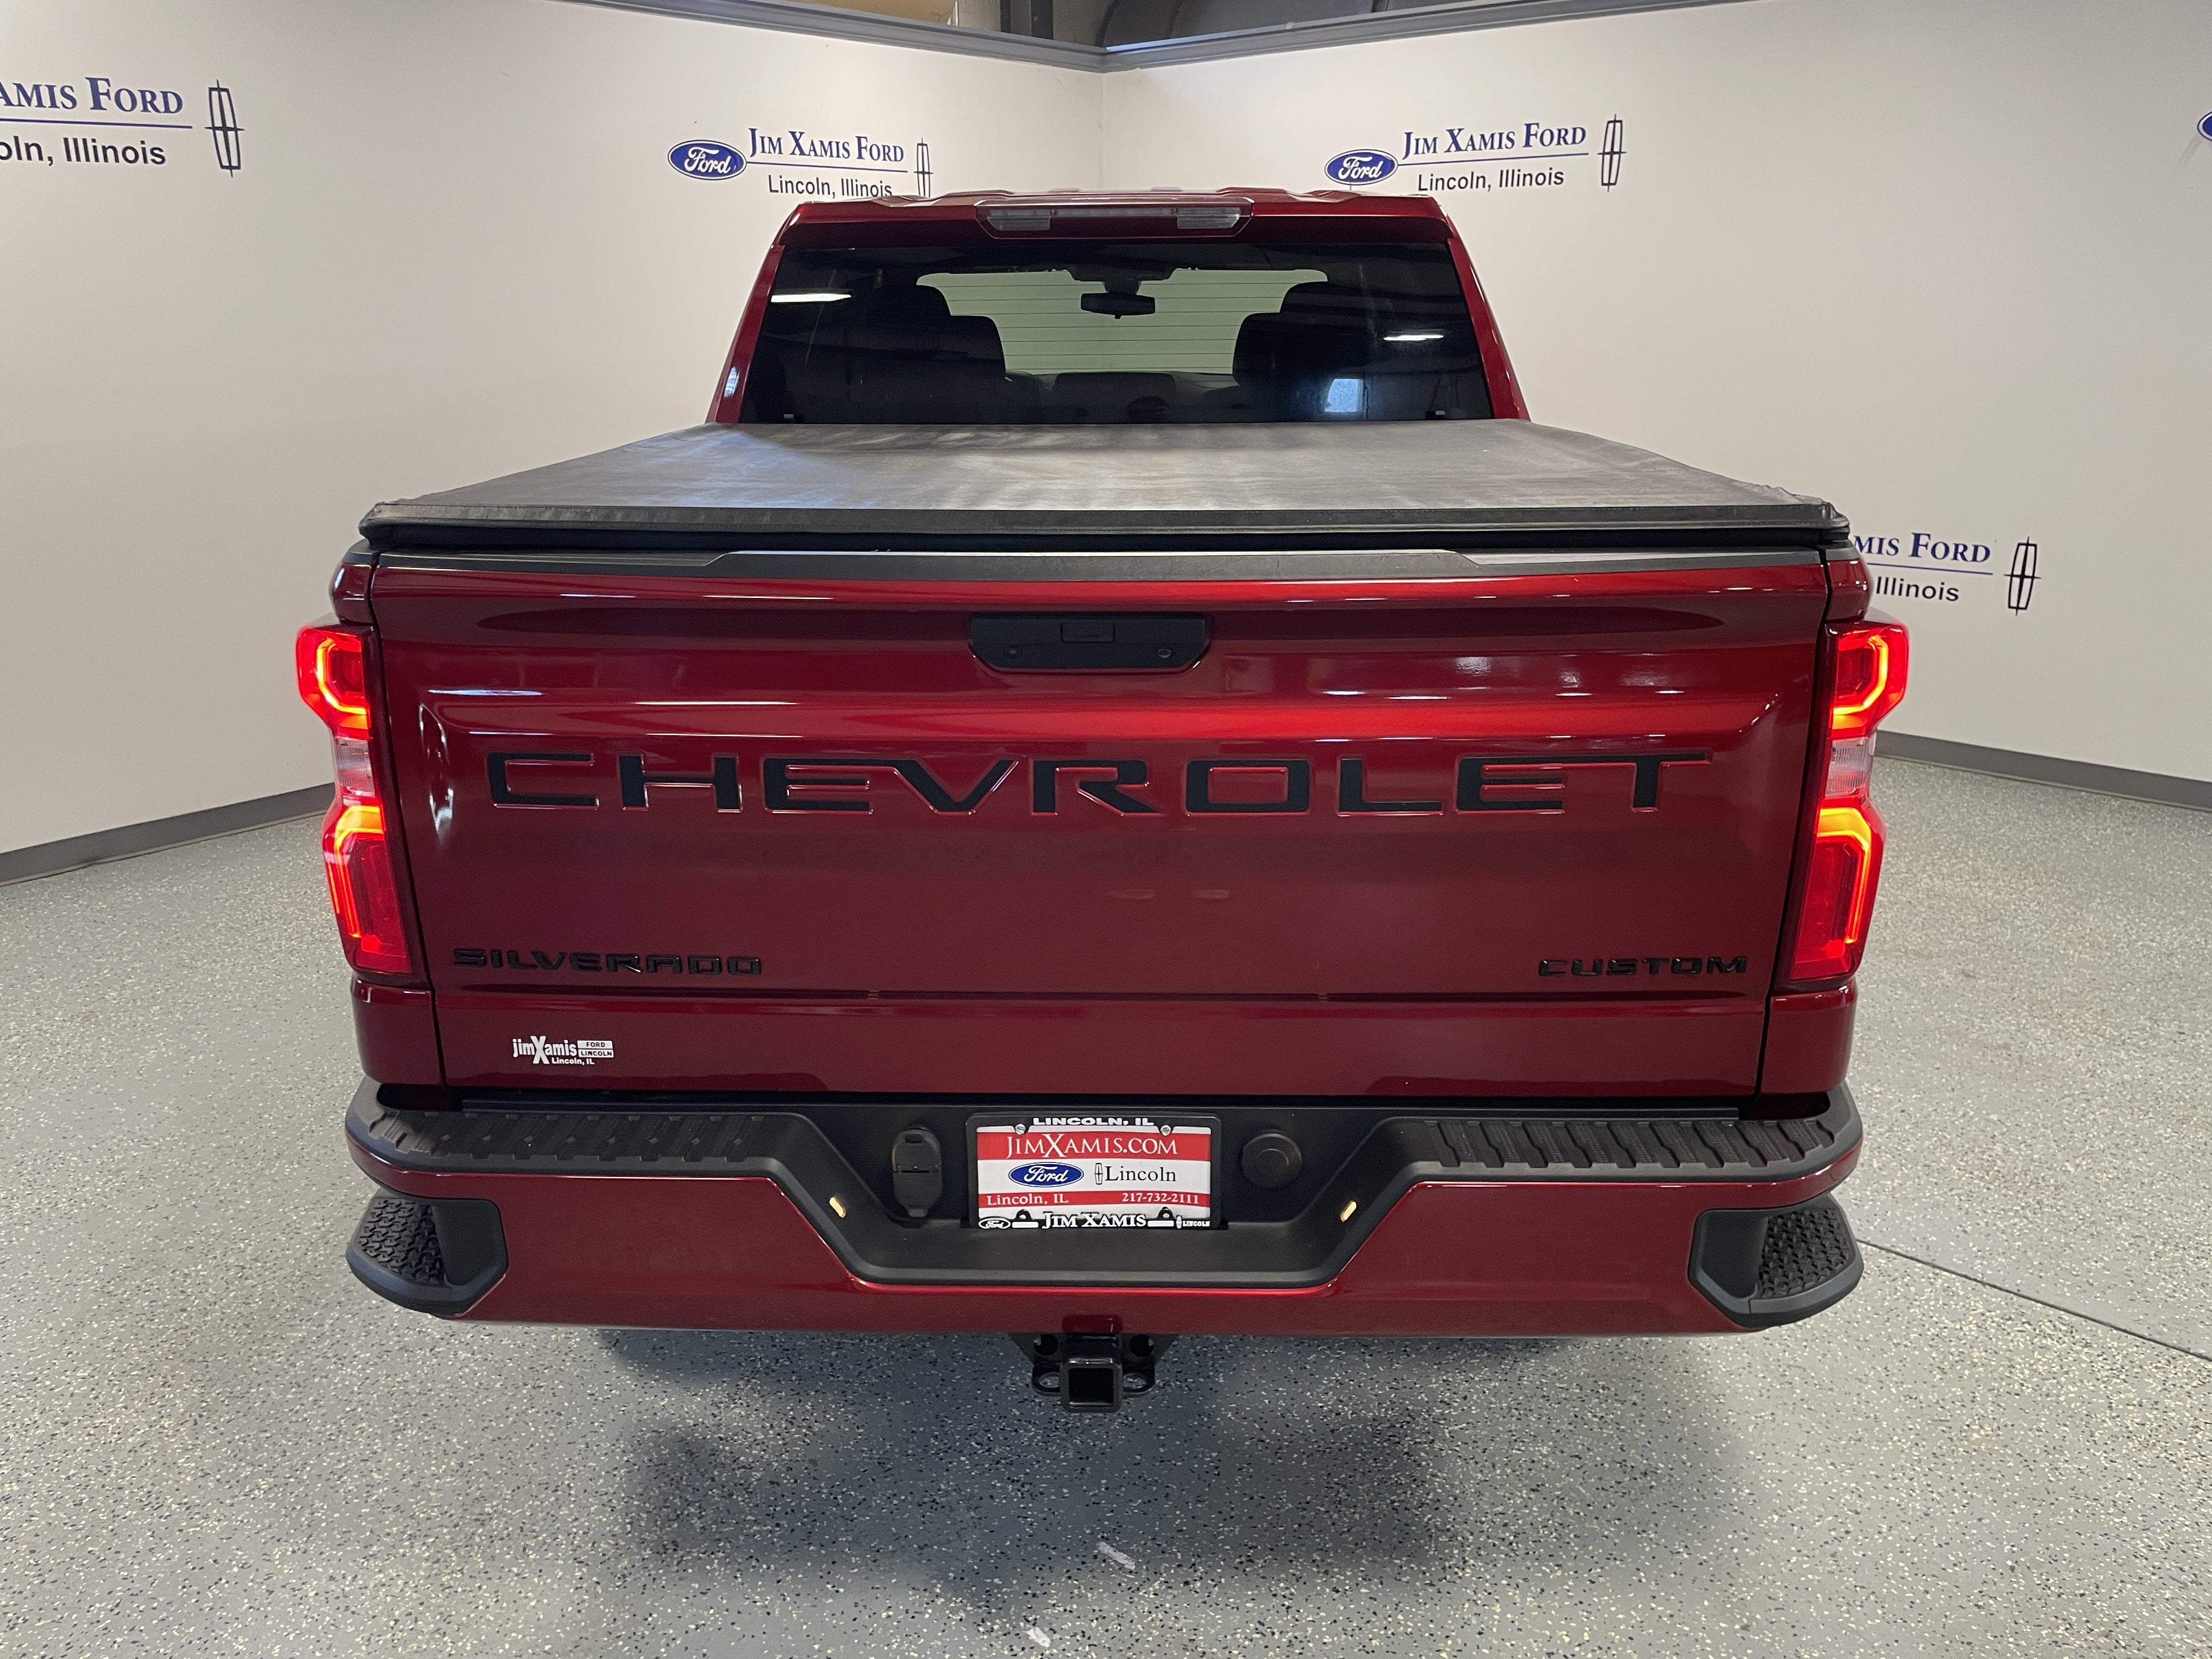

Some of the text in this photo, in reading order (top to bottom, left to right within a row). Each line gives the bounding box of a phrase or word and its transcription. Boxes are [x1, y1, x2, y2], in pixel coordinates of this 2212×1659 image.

[85, 77, 183, 114] FORD
[63, 137, 166, 165] Illinois
[748, 128, 904, 162] JIM XAMIS FORD
[1402, 122, 1587, 160] JIM XAMIS FORD
[684, 146, 732, 173] Ford
[1338, 156, 1384, 180] Ford
[769, 174, 893, 199] Lincoln, Illinois
[1418, 167, 1565, 192] Lincoln, Illinois
[1908, 532, 1990, 563] FORD
[1876, 576, 1959, 602] Illinois
[487, 751, 1712, 816] CHEVROLET
[453, 948, 762, 975] SILVERADO
[1538, 956, 1748, 977] CUSTOM
[551, 1057, 585, 1065] Lincoln,
[1033, 1118, 1154, 1126] LINCOLN, IL
[1023, 1166, 1069, 1182] Ford
[1104, 1166, 1176, 1182] Lincoln
[987, 1193, 1069, 1206] Lincoln, IL
[1121, 1192, 1199, 1204] 217-732-2111
[1042, 1212, 1147, 1229] JIM XAMIS
